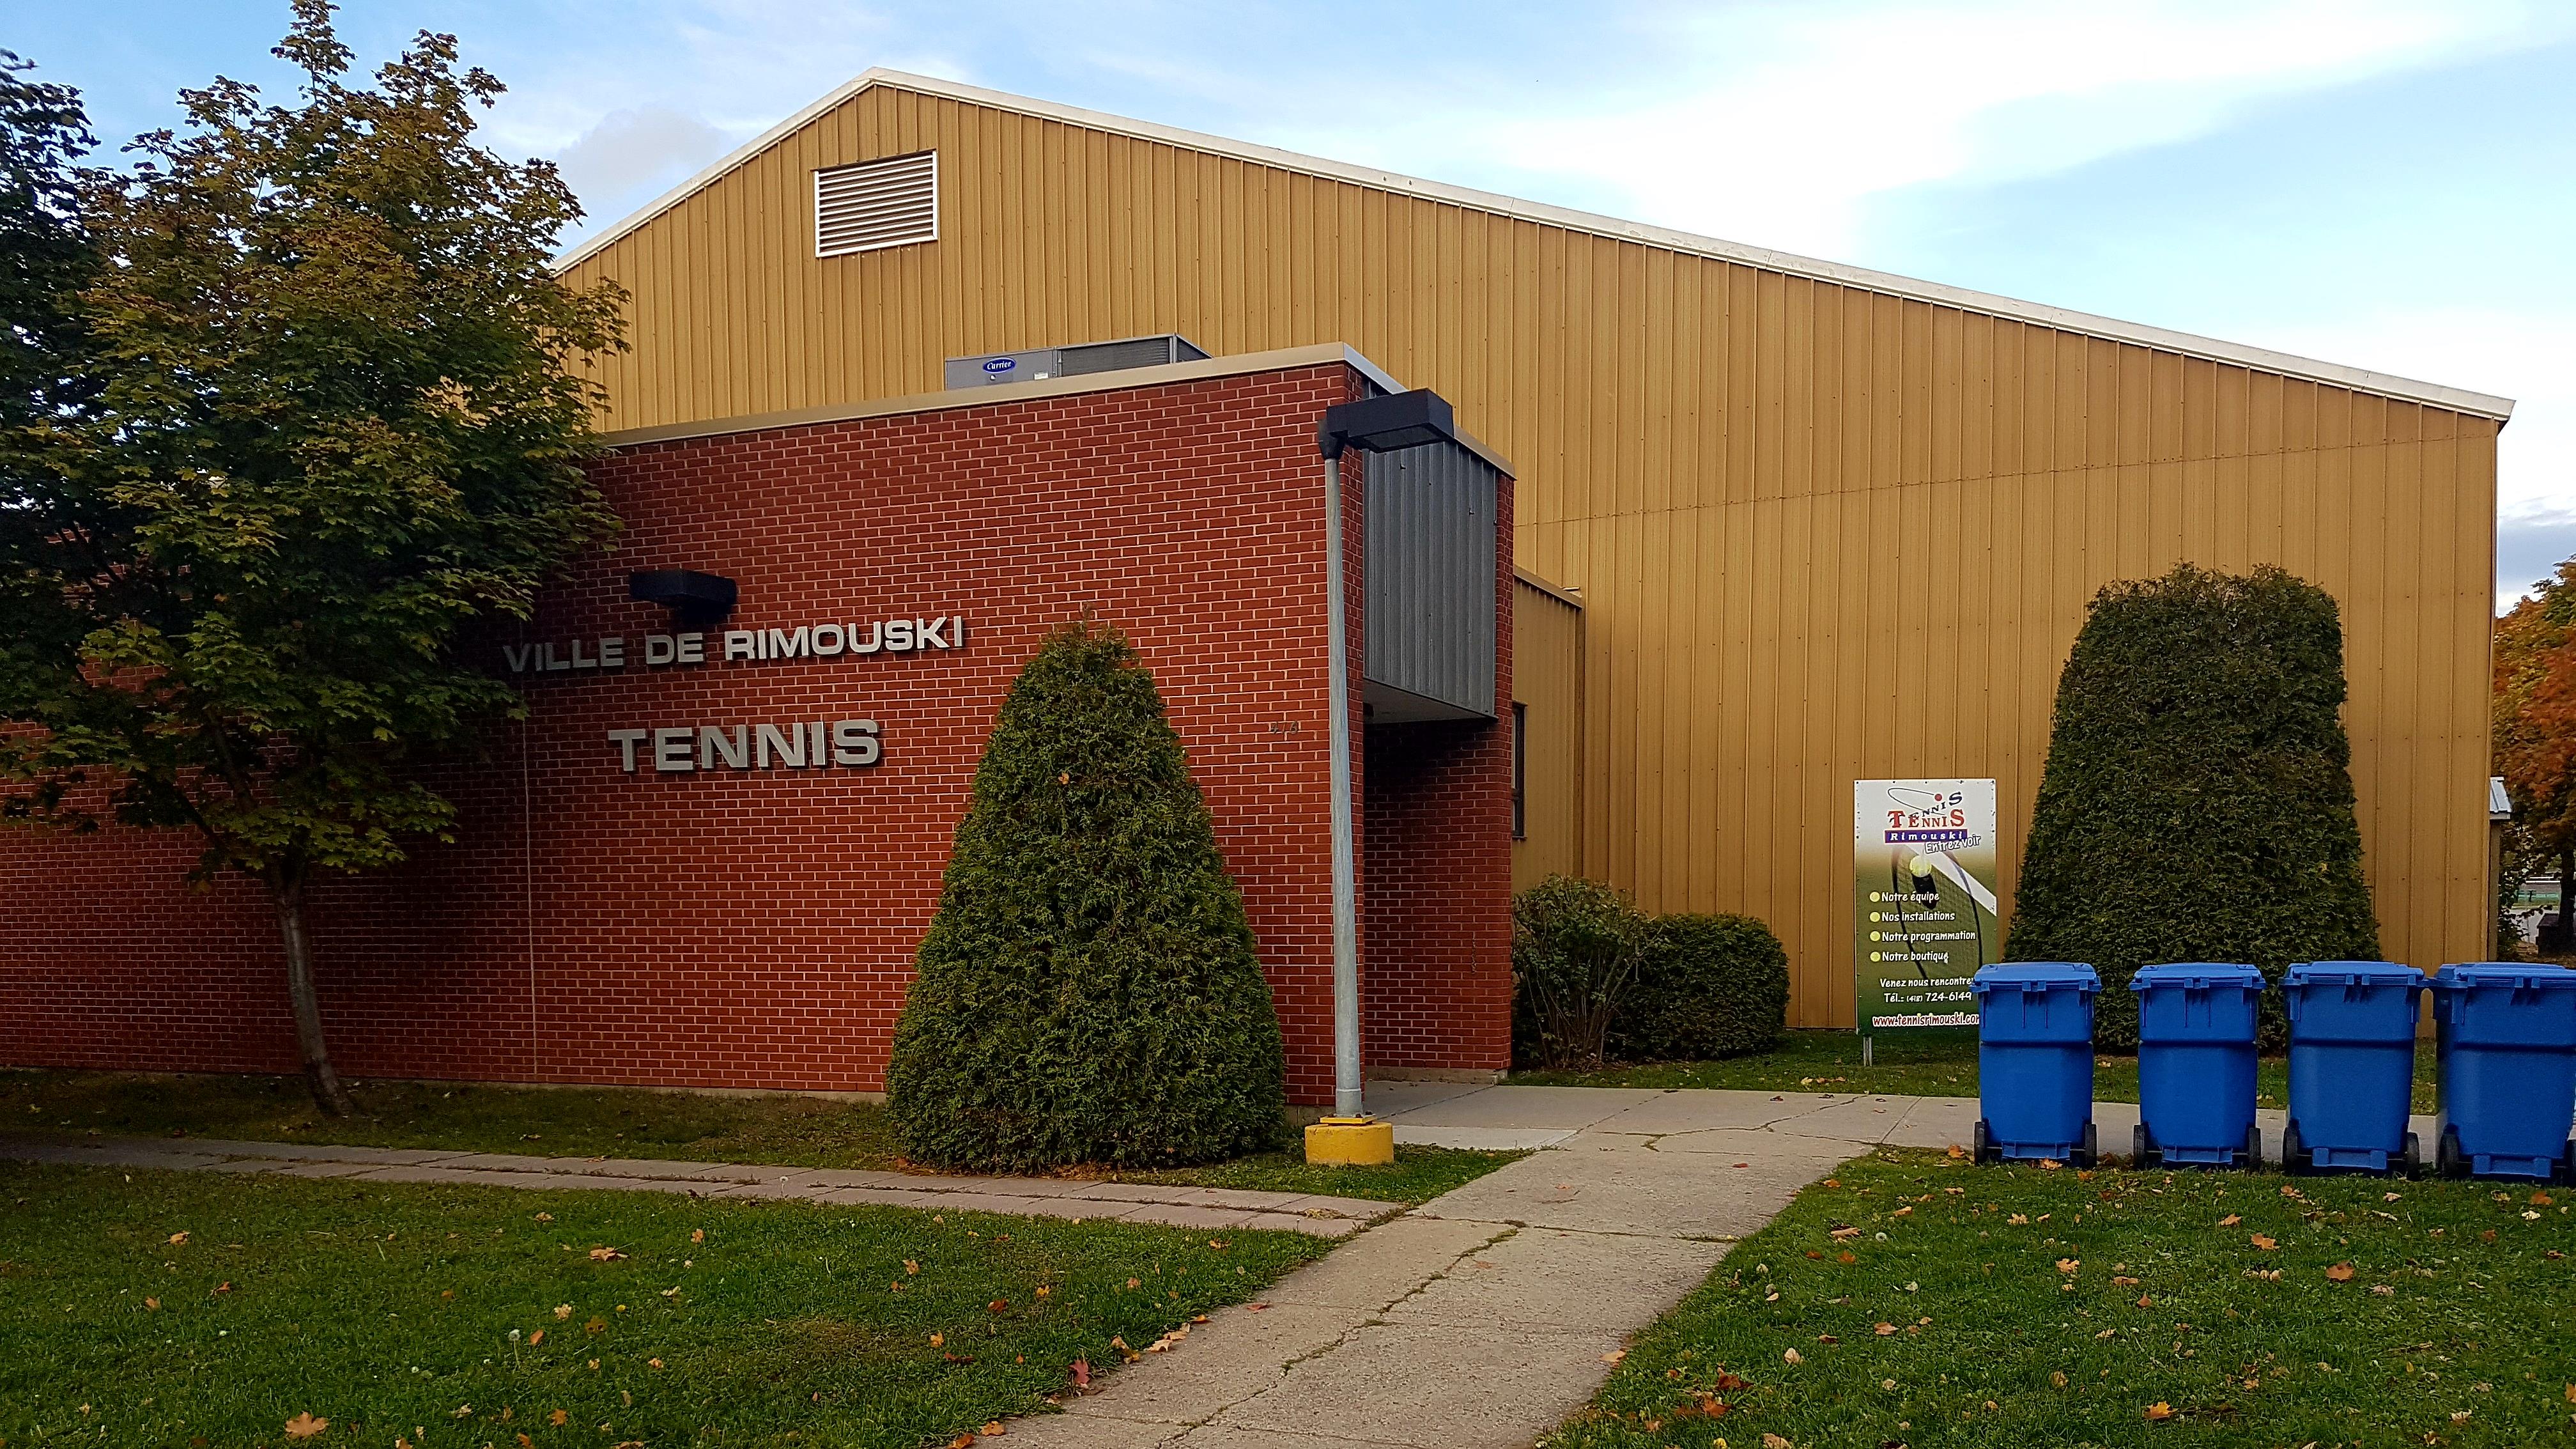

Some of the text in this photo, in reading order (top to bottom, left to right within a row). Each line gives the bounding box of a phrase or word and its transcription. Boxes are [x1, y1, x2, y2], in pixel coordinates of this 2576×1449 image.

[503, 616, 964, 671] VILLE DE RIMOUSKI
[1270, 721, 1298, 734] 416
[608, 719, 881, 771] TENNIS
[1887, 809, 1965, 828] TENNIS
[1890, 831, 1963, 841] Rimouski
[1925, 833, 1981, 854] Entrez voir
[1881, 891, 1940, 903] Notre équipe
[1881, 911, 1955, 921] Nos installations
[1882, 931, 1975, 943] Notre programmation
[1882, 951, 1948, 963] Notre boutique
[1879, 978, 1906, 988] Venez
[1908, 978, 1929, 986] nous
[1925, 991, 1972, 1002] 724-6149
